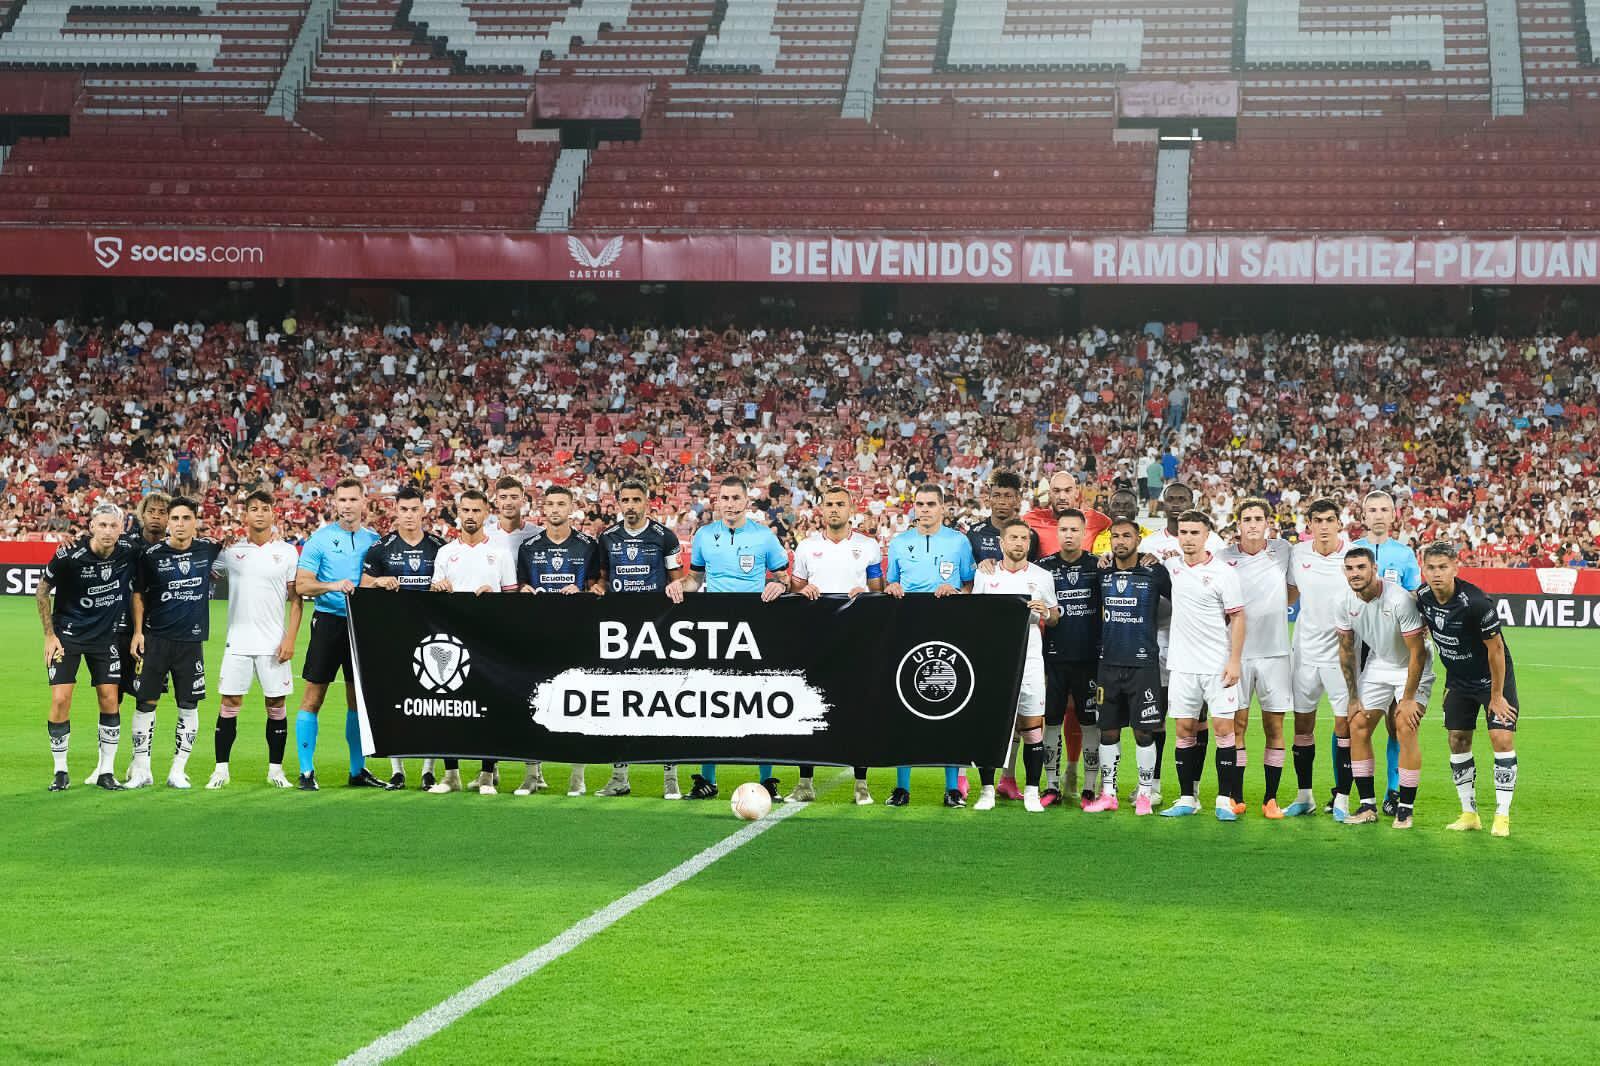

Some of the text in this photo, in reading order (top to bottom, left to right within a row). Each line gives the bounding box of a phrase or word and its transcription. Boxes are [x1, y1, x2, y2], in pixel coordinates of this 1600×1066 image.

[130, 244, 263, 263] SOCIOS.com
[770, 240, 1598, 280] BIENVENIDOS AL RAMON SANCHEZ-PIZJUAN
[569, 270, 622, 279] CASTORE
[599, 621, 762, 660] BASTA
[912, 647, 957, 665] UEFA
[563, 689, 794, 719] DE RACISMO
